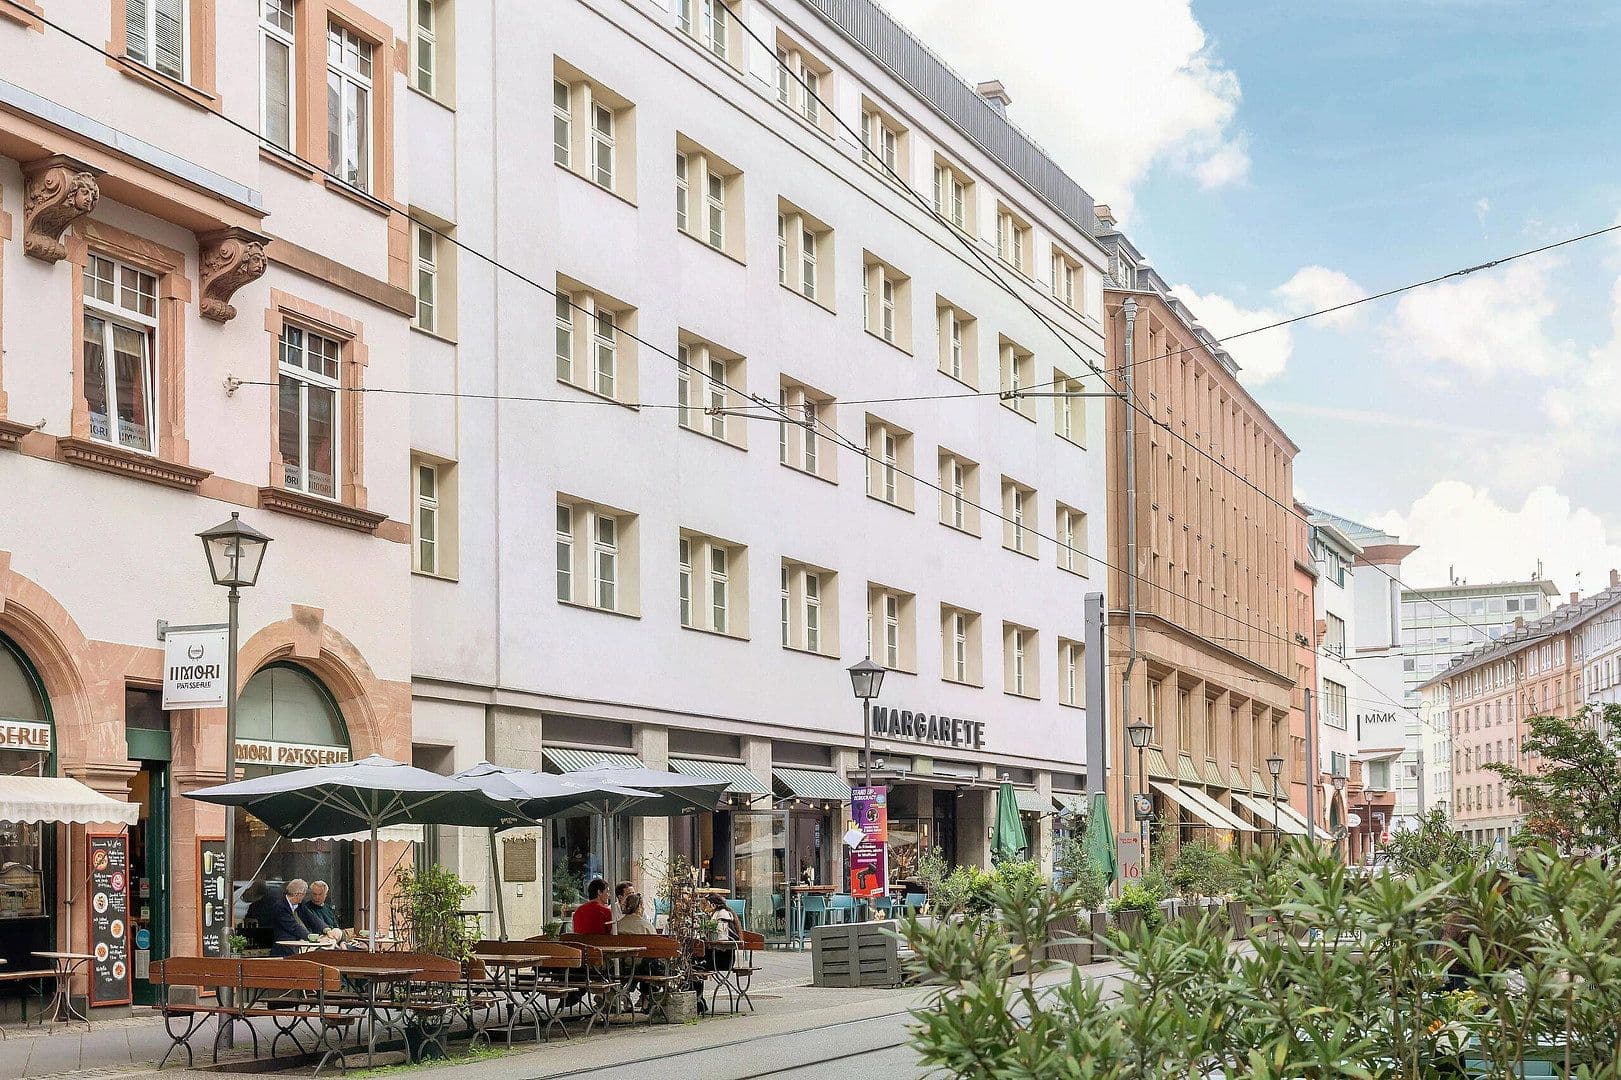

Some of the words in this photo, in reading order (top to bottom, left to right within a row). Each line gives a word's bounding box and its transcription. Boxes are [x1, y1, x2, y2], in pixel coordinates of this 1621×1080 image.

[169, 664, 220, 681] IIMORI
[1365, 712, 1396, 723] MMK
[872, 705, 986, 750] MARGARETE
[1122, 861, 1139, 878] 16
